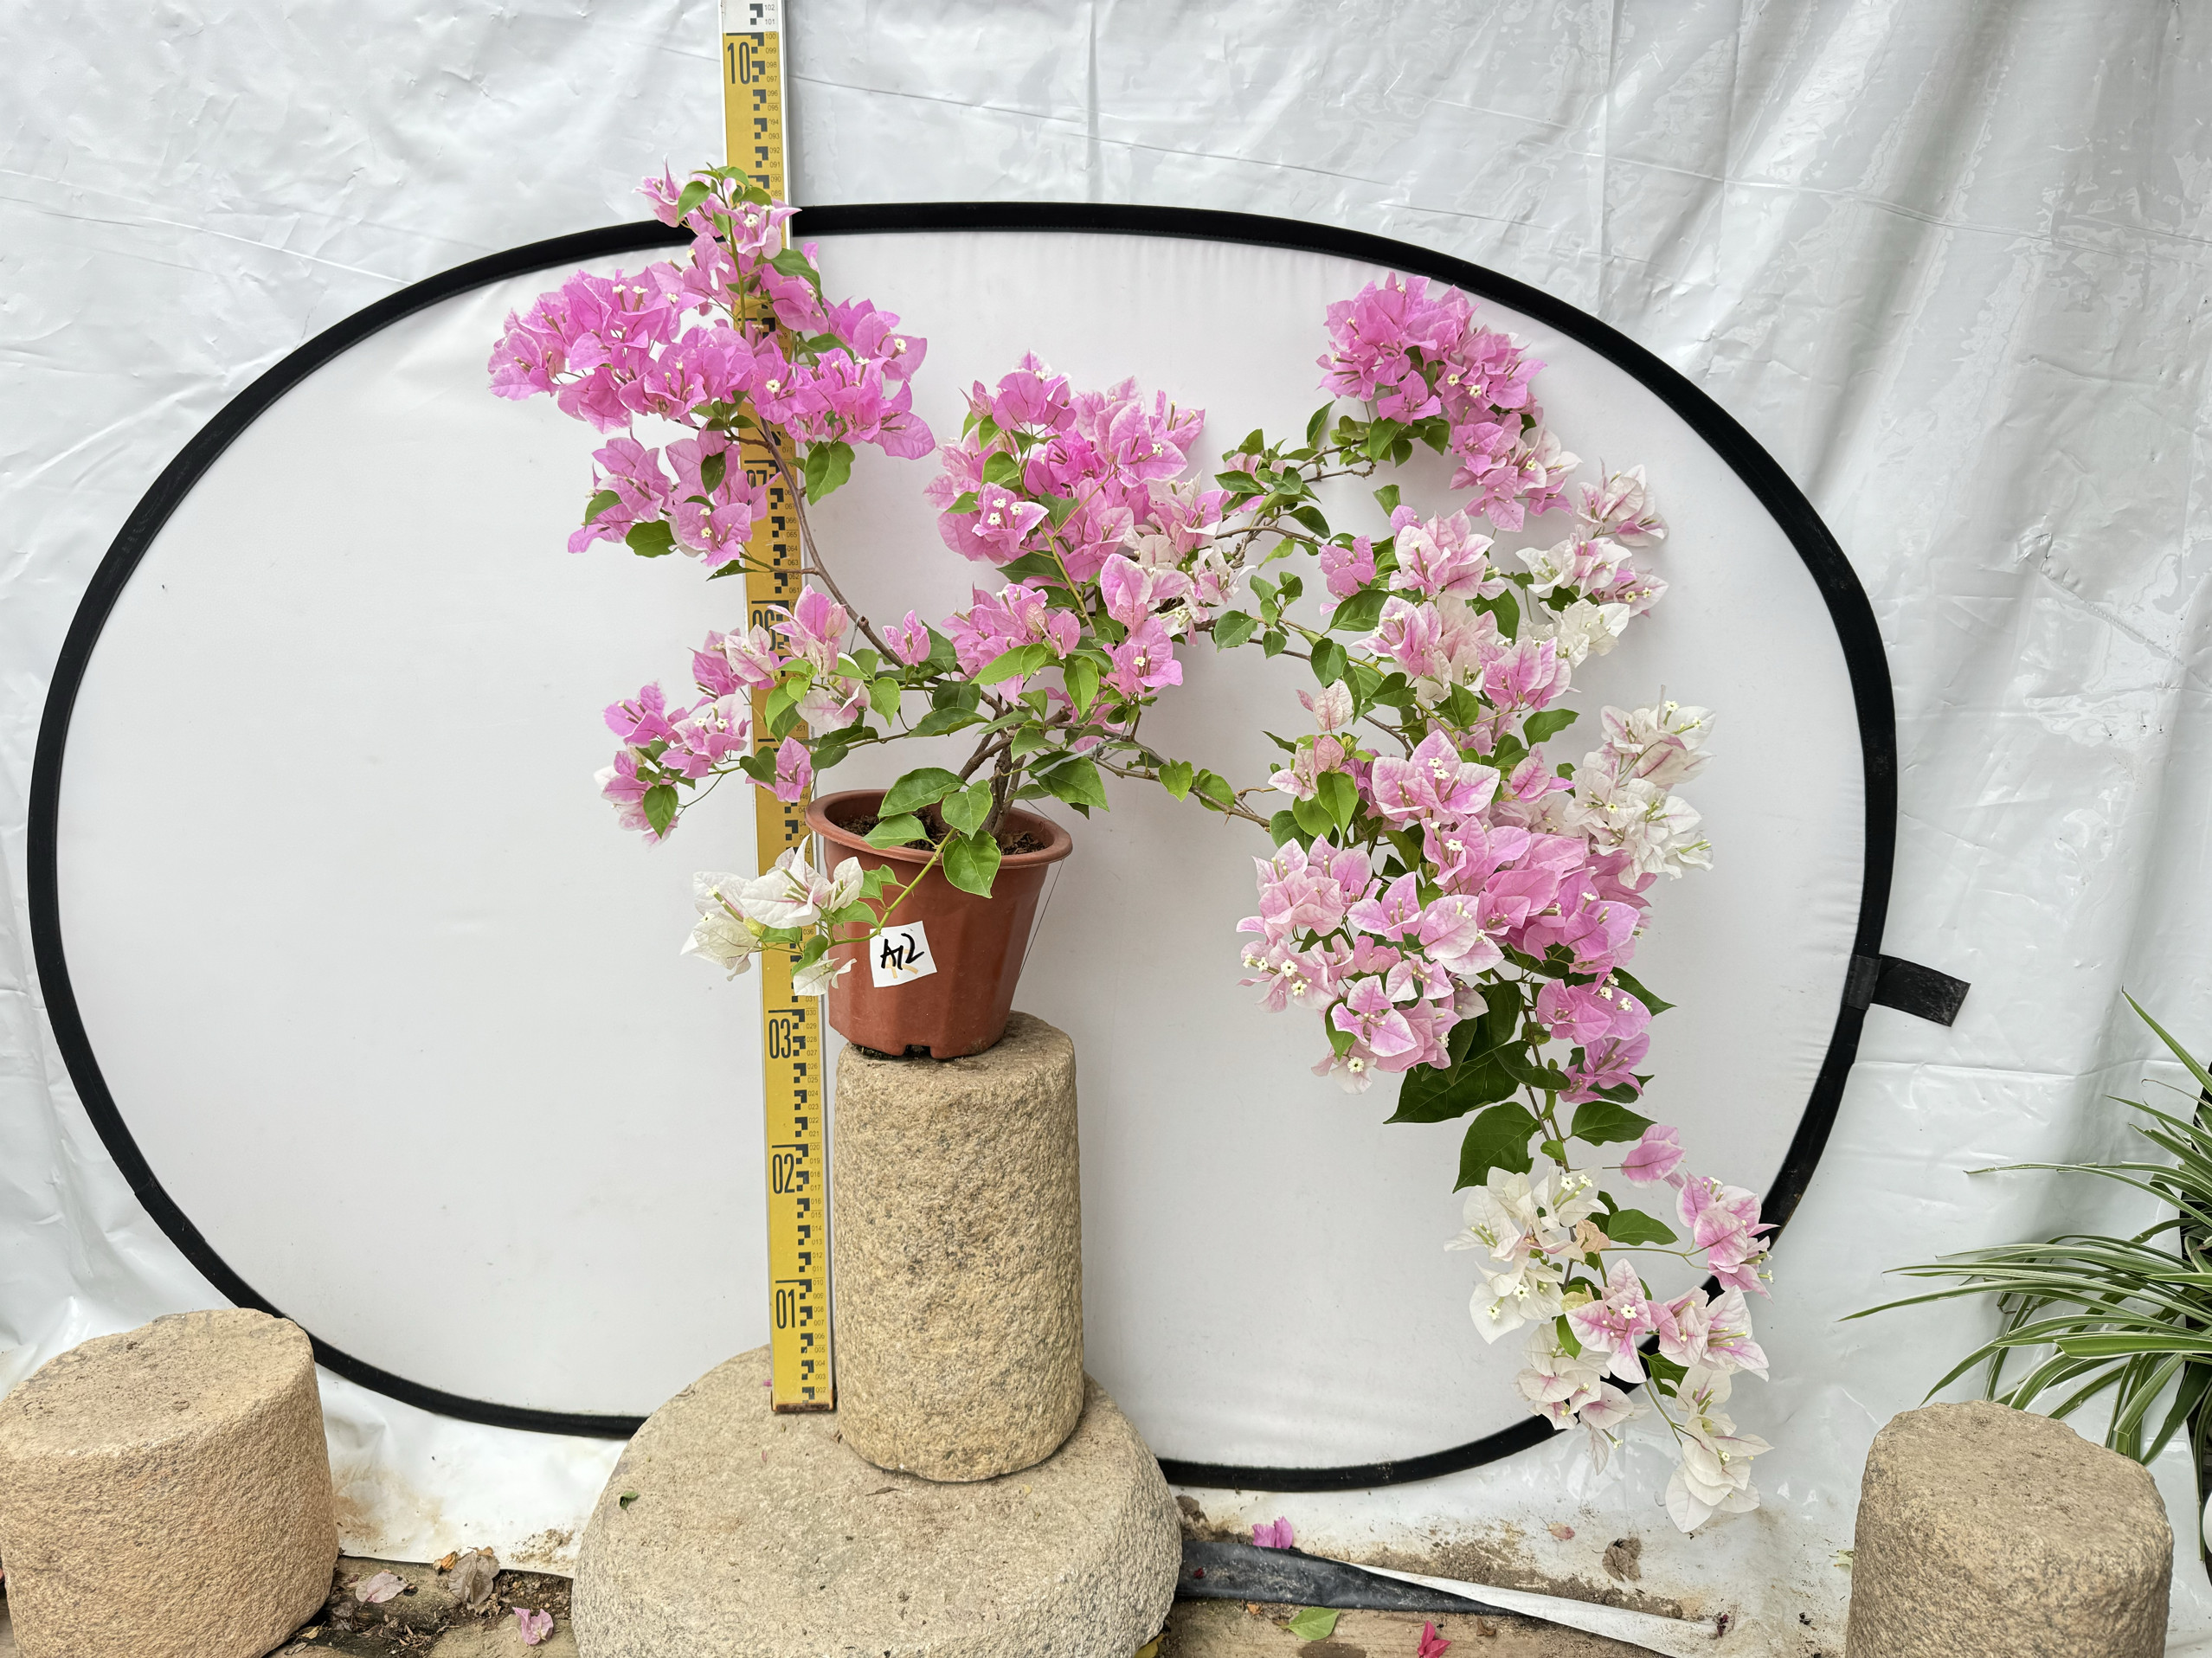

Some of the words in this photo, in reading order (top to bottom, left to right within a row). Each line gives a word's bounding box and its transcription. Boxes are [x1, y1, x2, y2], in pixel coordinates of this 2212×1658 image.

[727, 42, 751, 84] 10
[880, 933, 925, 970] A12
[769, 1018, 791, 1059] 03
[772, 1153, 795, 1194] 02
[776, 1289, 795, 1329] 01
